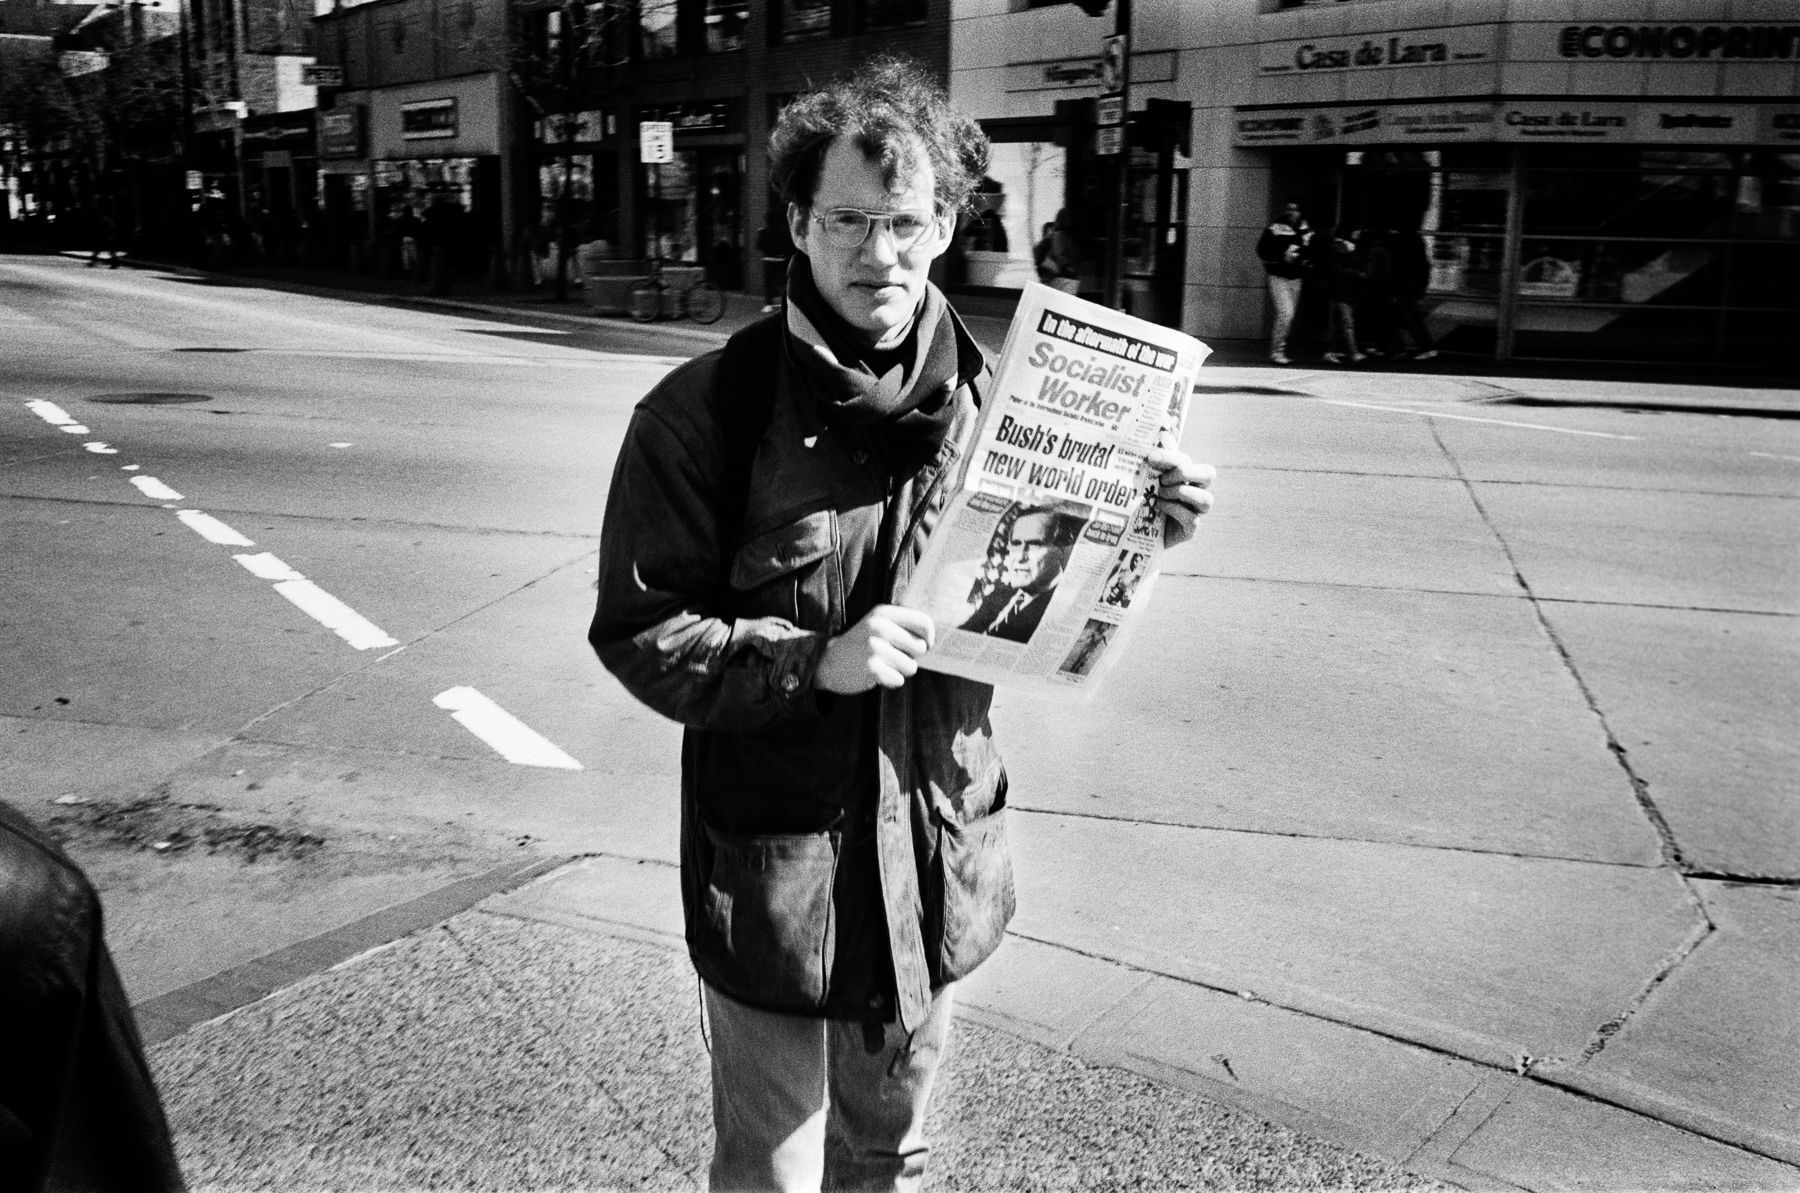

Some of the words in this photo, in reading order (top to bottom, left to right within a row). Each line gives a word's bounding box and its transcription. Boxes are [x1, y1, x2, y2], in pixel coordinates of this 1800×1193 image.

[1296, 44, 1350, 69] Casa
[1355, 41, 1382, 65] de
[1388, 37, 1446, 64] Lara
[1042, 313, 1058, 334] In
[1056, 319, 1077, 341] the
[1074, 326, 1129, 357] aftermath
[1126, 342, 1142, 360] of
[1138, 344, 1157, 366] the
[1028, 341, 1146, 397] Socialist
[1037, 375, 1132, 423] Worker
[995, 414, 1058, 455] Bush's
[1057, 432, 1115, 470] brutal
[982, 450, 1027, 480] new
[1027, 462, 1086, 496] world
[1084, 479, 1138, 508] order
